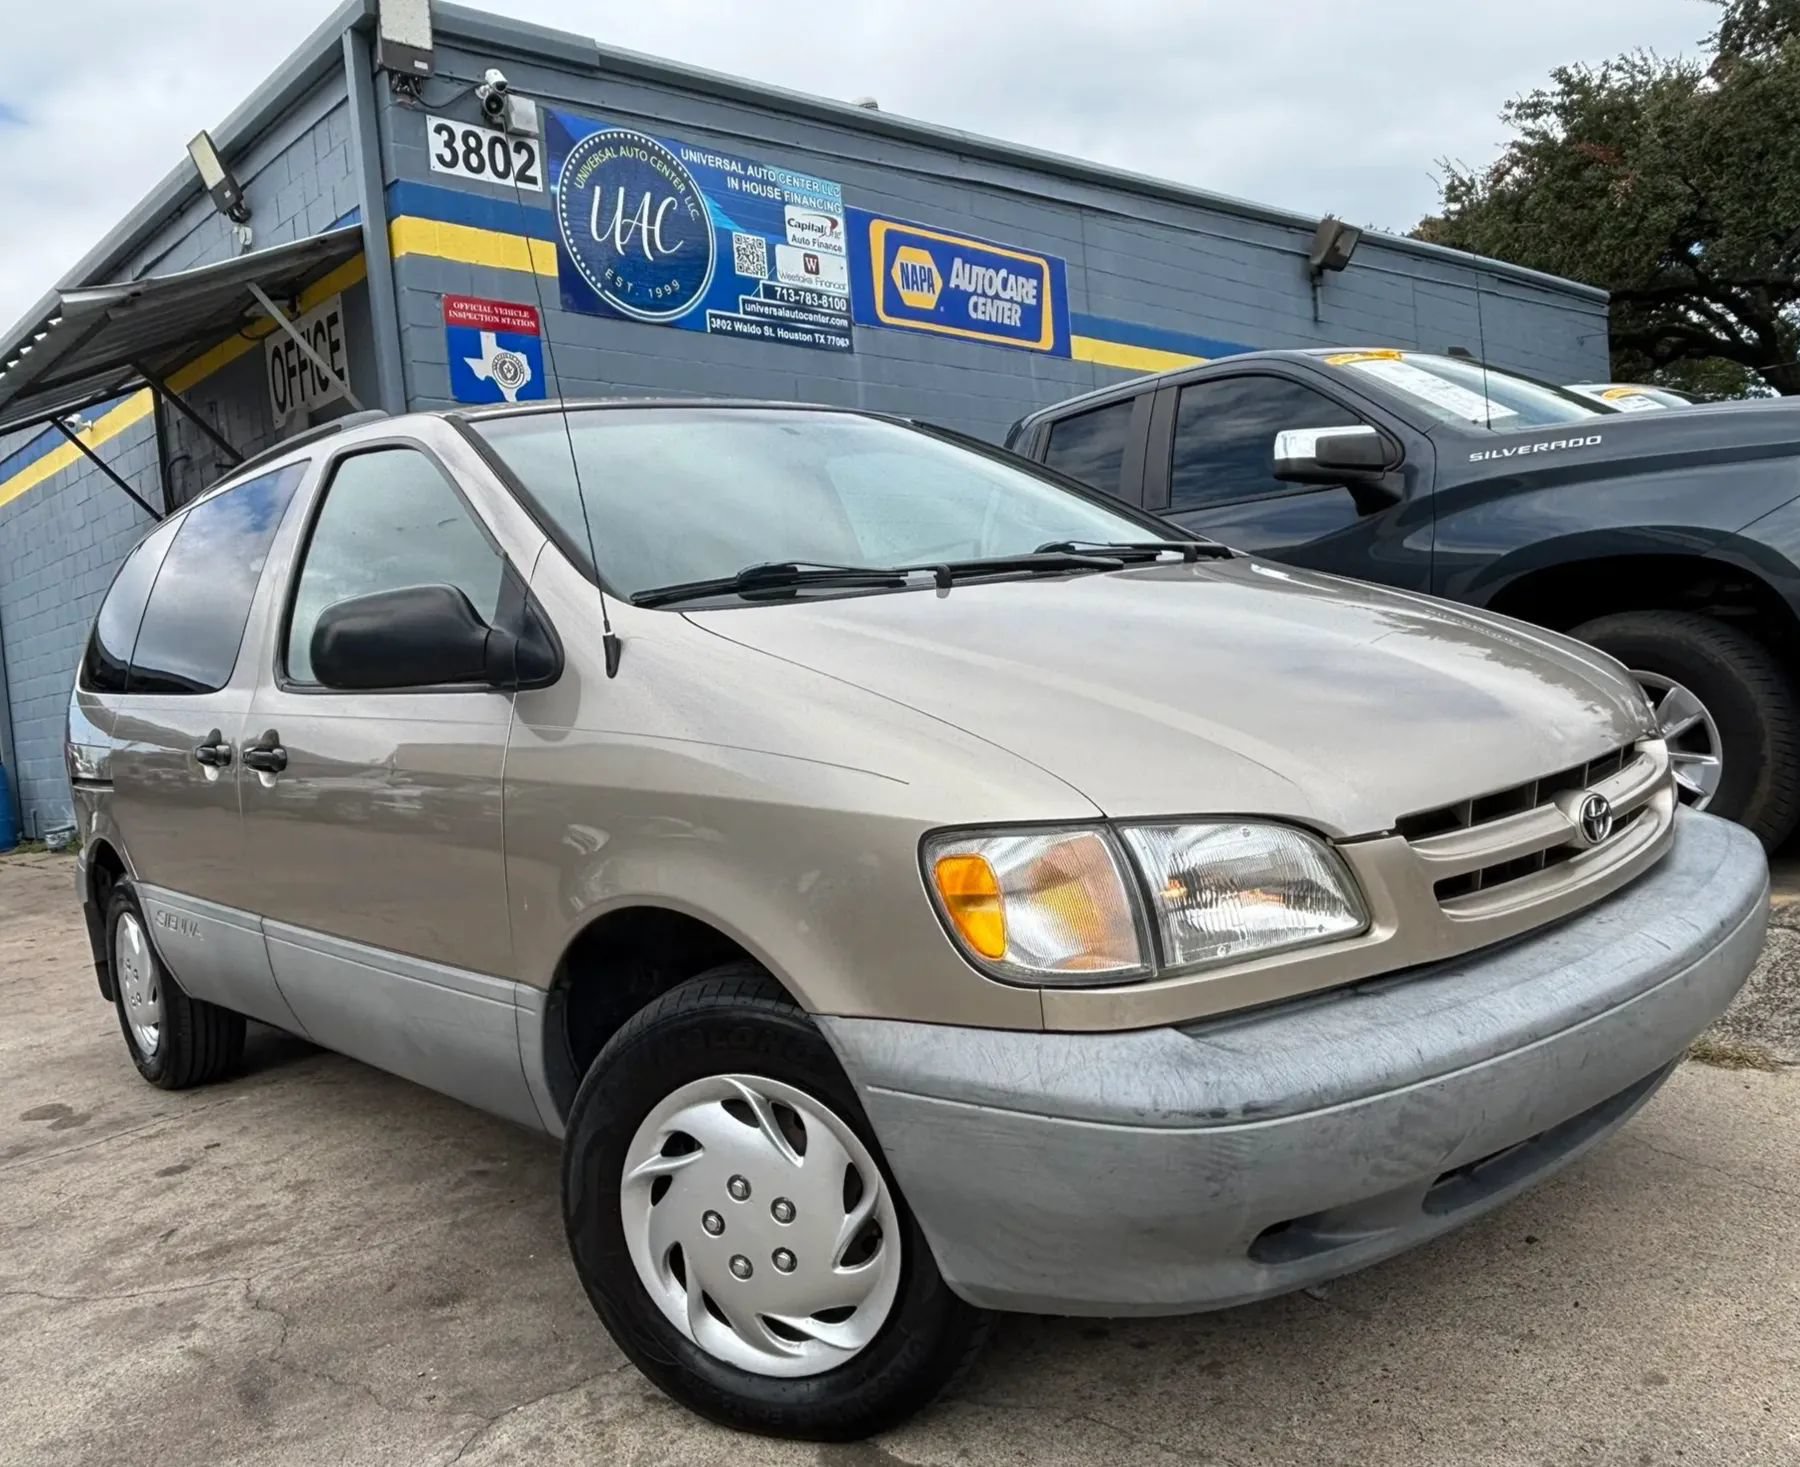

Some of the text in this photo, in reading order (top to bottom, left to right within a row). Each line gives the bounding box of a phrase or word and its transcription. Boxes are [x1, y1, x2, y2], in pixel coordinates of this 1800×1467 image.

[433, 123, 538, 186] 3802
[574, 146, 618, 189] UNIVERSAL
[620, 146, 648, 161] AUTO
[650, 156, 686, 194] CENTER
[681, 147, 841, 198] UNIVERSAL AUTO CENTER LLC
[727, 177, 842, 214] IN HOUSE FINANCING
[791, 234, 843, 253] Auto Finance
[604, 268, 680, 299] EST. 1999
[899, 262, 935, 295] NAPA
[449, 310, 536, 328] INSPECTION STATION
[453, 302, 530, 319] OFFICIAL VEHICLE
[745, 302, 849, 328] universalautocenter.com
[968, 295, 1021, 327] CENTER
[711, 318, 732, 330] 3802
[733, 321, 761, 335] Waldo
[777, 328, 813, 342] Houston
[814, 333, 826, 344] TX
[271, 311, 345, 414] OFFICE
[1468, 435, 1602, 462] SILVERADO
